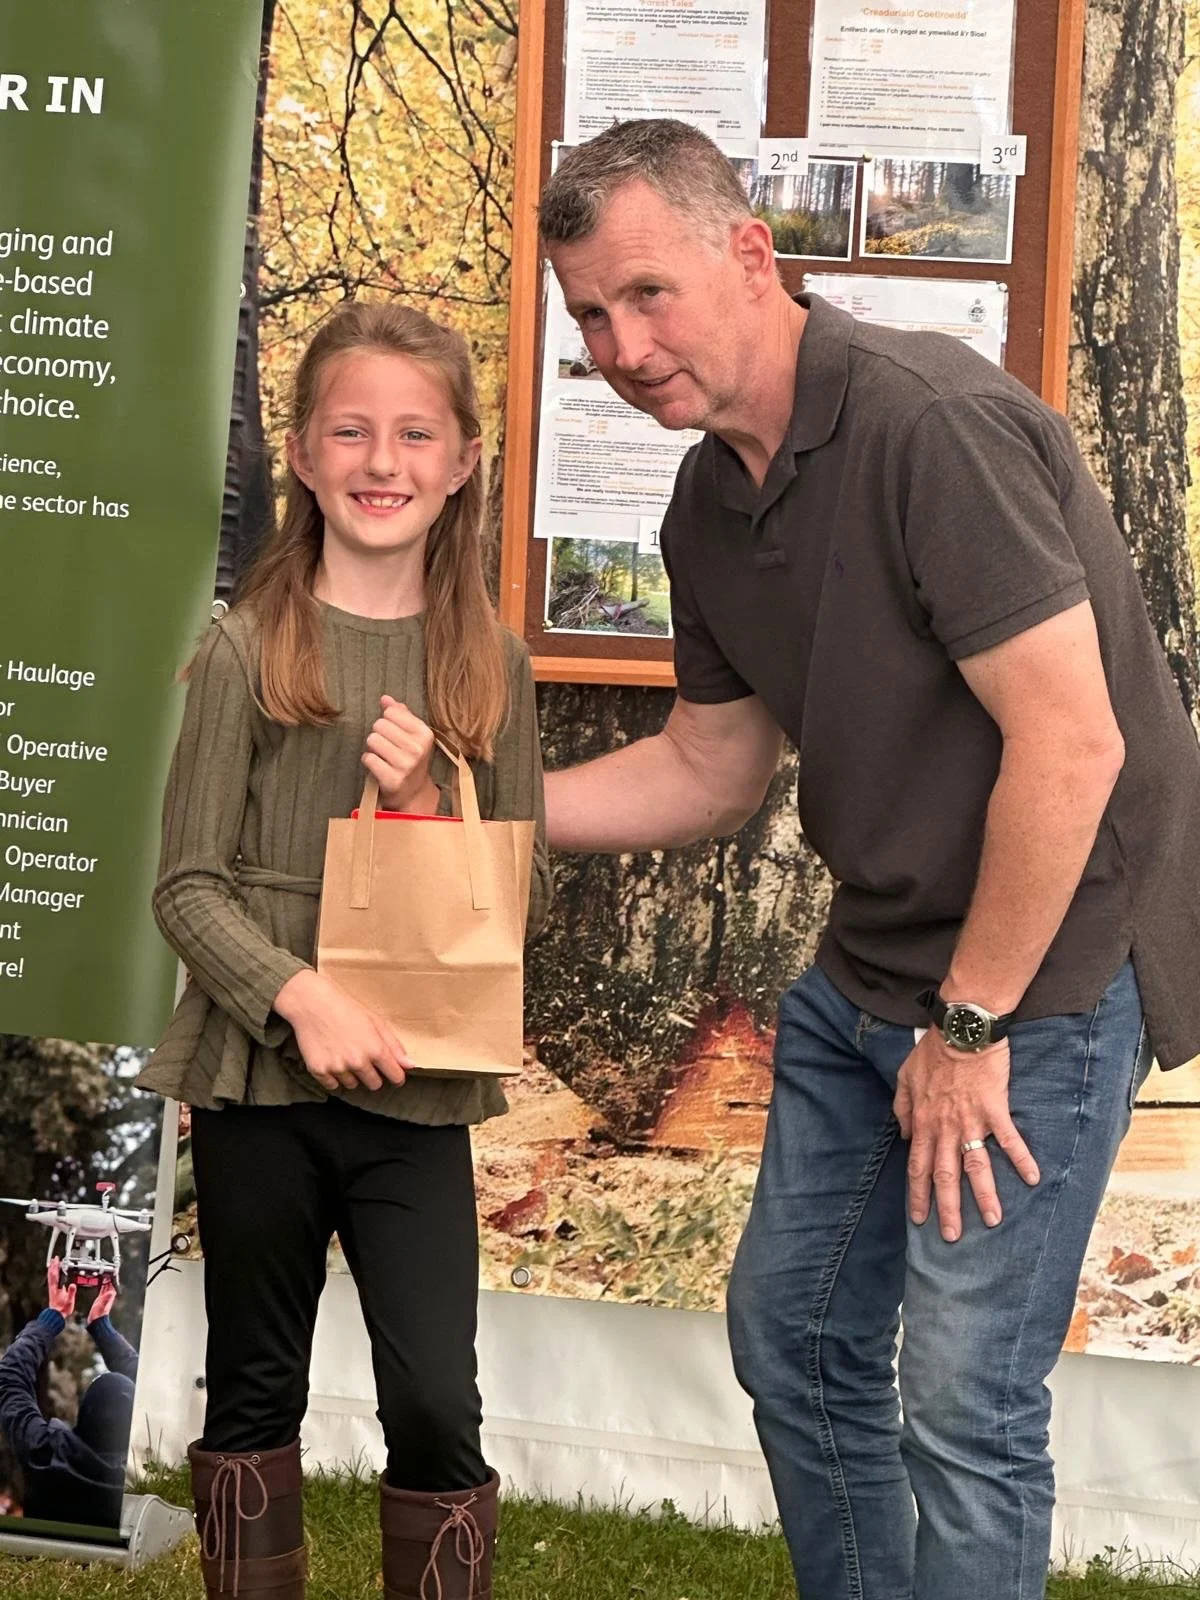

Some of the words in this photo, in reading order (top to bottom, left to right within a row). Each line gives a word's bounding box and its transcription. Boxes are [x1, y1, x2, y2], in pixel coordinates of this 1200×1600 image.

[46, 76, 104, 114] IN
[771, 149, 798, 170] 2nd
[992, 144, 1017, 164] 3rd
[0, 228, 54, 260] ging
[63, 231, 113, 256] and
[10, 308, 109, 339] climate
[0, 355, 115, 386] conomy,
[0, 389, 79, 419] hoice.
[0, 454, 60, 478] ience,
[22, 496, 87, 515] sector
[93, 496, 129, 518] has
[8, 660, 95, 691] Haulage
[7, 734, 107, 762] Operative
[0, 770, 56, 797] Buyer
[6, 846, 98, 873] Operator
